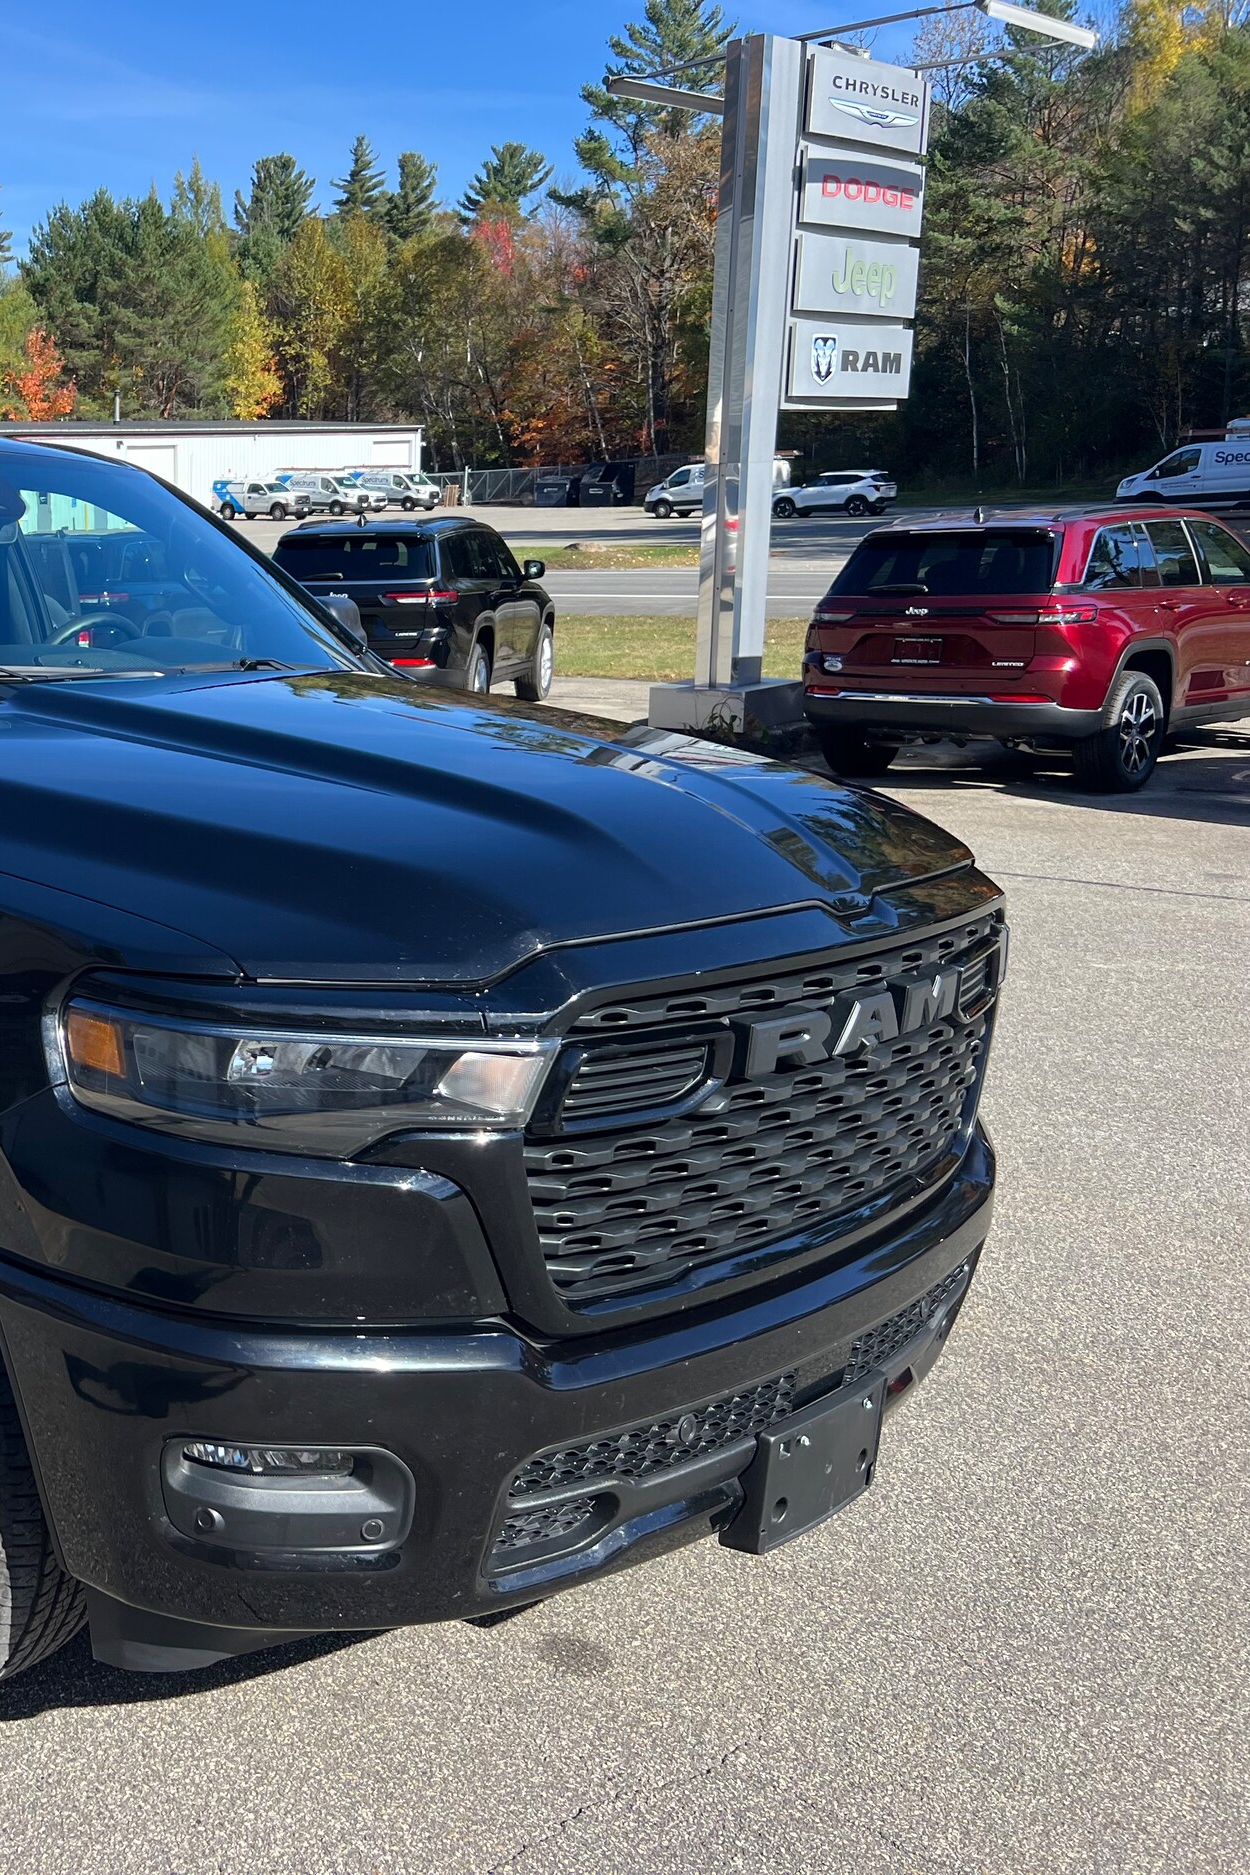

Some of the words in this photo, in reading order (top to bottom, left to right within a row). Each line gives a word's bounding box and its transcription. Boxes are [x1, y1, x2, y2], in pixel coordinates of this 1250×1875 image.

[832, 75, 919, 108] CHRYSLER
[821, 173, 915, 211] DODGE
[831, 246, 897, 307] Jeep
[840, 349, 902, 375] RAM
[289, 479, 317, 487] Spectrum
[361, 476, 389, 484] Spectrum
[905, 606, 929, 616] Jeep
[745, 965, 958, 1079] RAM
